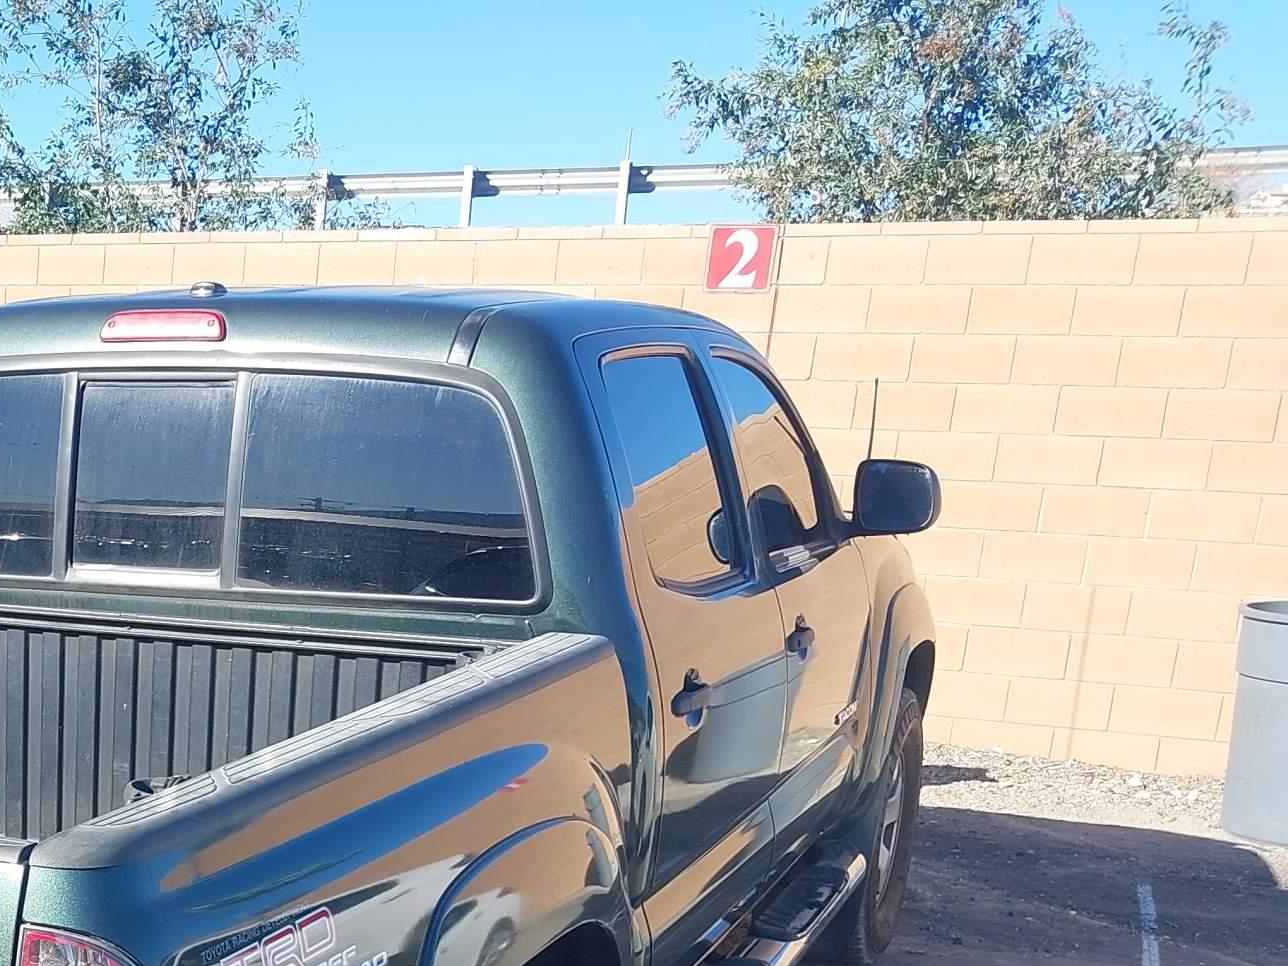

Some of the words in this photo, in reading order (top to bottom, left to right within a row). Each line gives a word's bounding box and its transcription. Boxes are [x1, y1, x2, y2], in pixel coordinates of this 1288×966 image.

[717, 229, 759, 288] 2
[200, 938, 232, 965] TOYOTA
[232, 924, 261, 947] RACING
